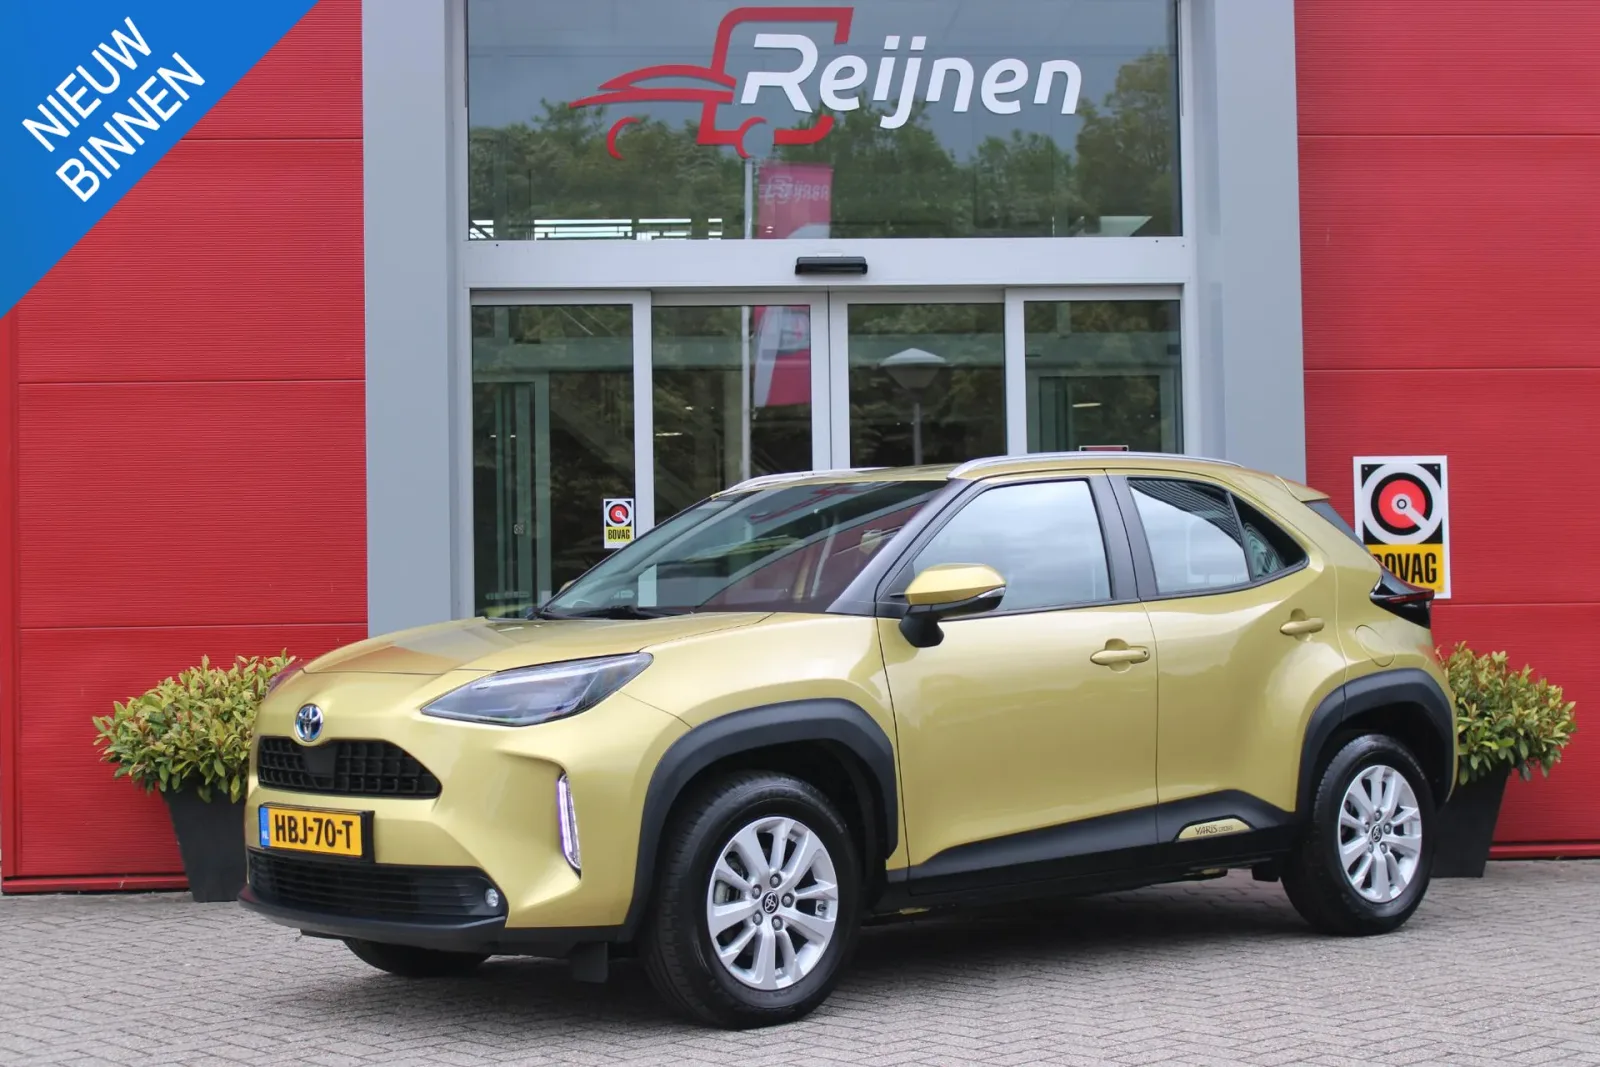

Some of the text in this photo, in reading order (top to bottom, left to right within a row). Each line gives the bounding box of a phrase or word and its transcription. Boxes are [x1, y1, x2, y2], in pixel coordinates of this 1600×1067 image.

[741, 33, 1082, 129] Reijnen
[608, 529, 630, 540] BOVAG
[1374, 552, 1437, 584] OVAG
[274, 814, 353, 849] HBJ-70-T
[1194, 825, 1218, 835] YARIS
